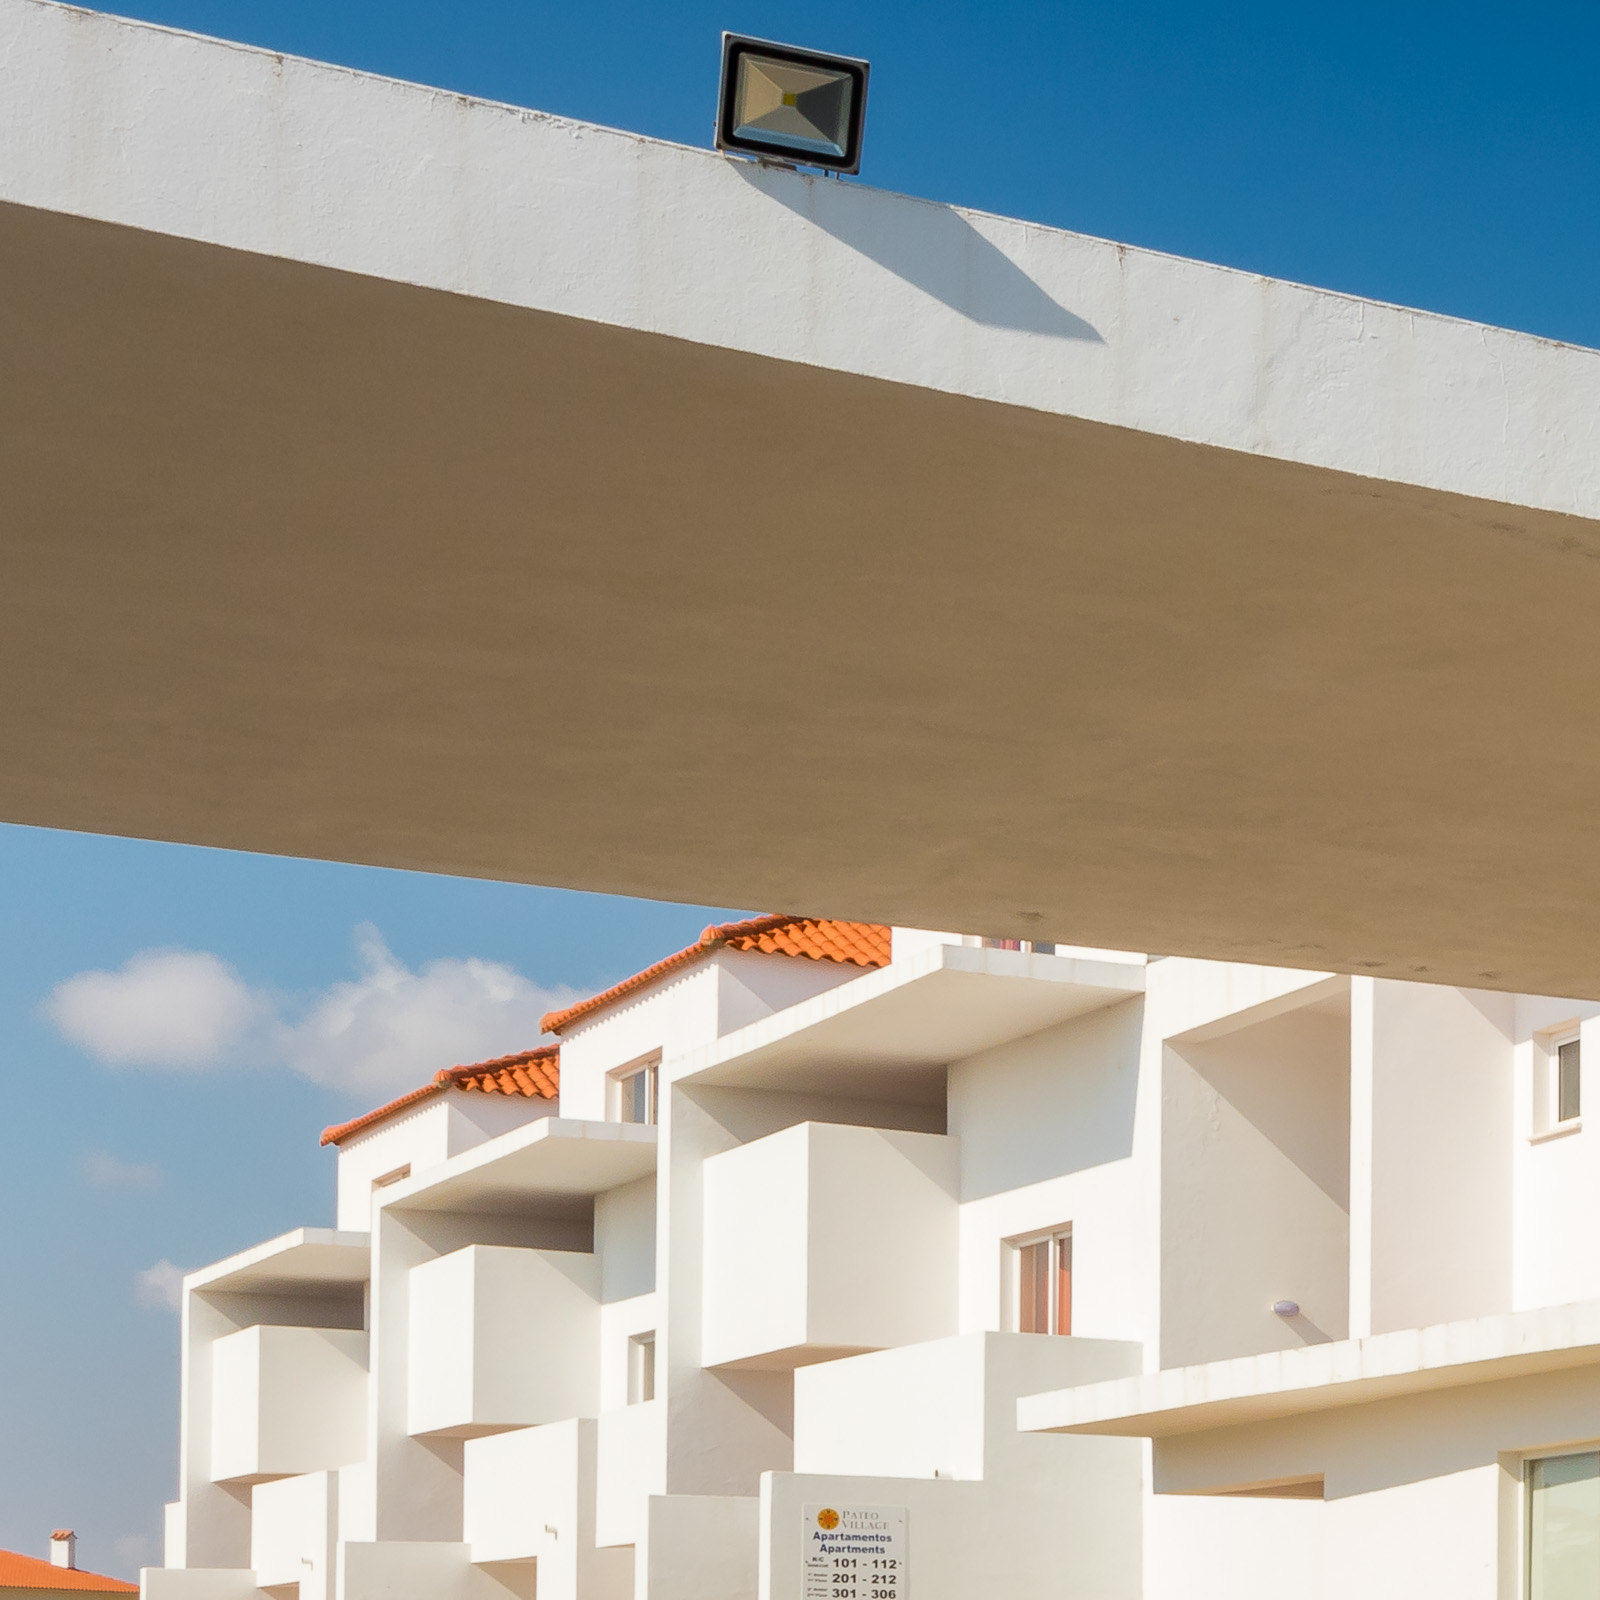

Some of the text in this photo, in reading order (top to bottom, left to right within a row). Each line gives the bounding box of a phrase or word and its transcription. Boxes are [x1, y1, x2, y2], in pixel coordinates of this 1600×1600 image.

[842, 1510, 879, 1520] PATEO
[841, 1520, 889, 1530] VILLAGE
[813, 1531, 892, 1543] Apartamentos
[820, 1543, 886, 1555] Apartments
[833, 1558, 857, 1568] 101
[872, 1559, 897, 1569] 112
[832, 1573, 857, 1583] 201
[871, 1574, 897, 1584] 212
[832, 1588, 857, 1598] 301
[871, 1589, 896, 1599] 306
